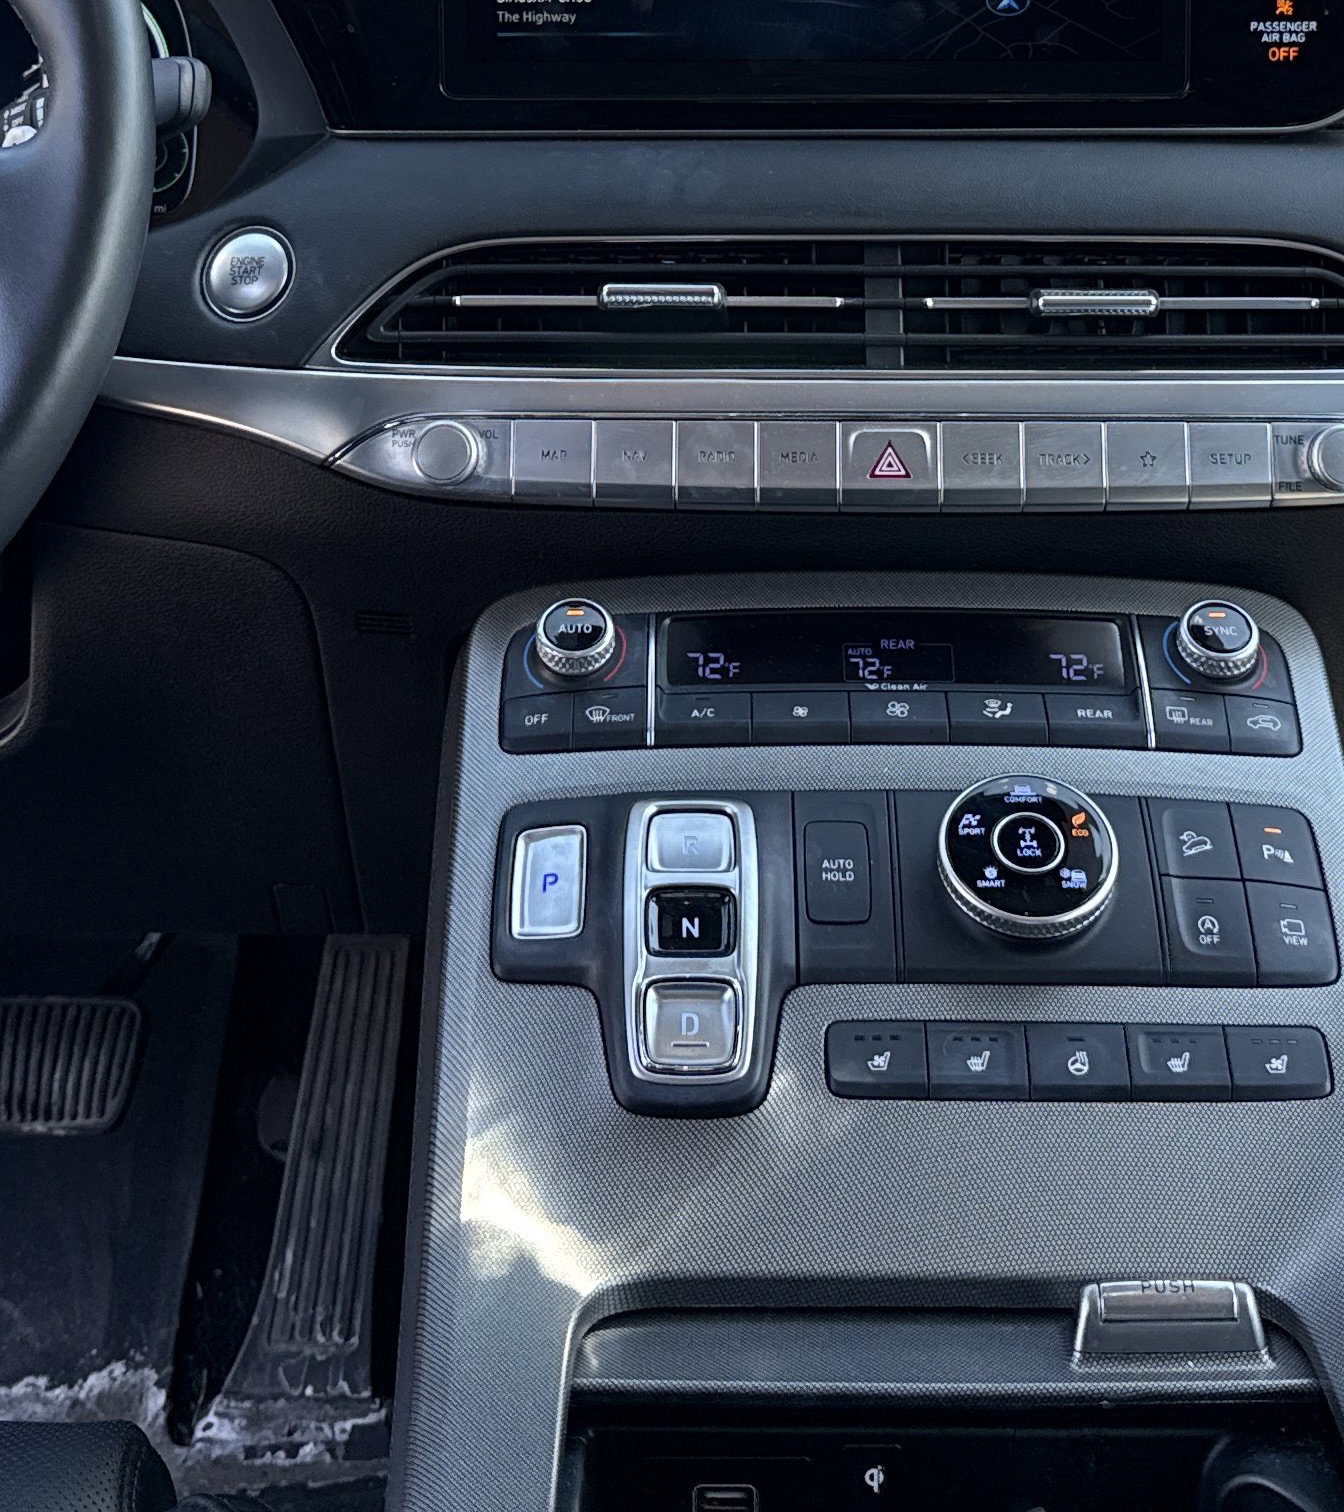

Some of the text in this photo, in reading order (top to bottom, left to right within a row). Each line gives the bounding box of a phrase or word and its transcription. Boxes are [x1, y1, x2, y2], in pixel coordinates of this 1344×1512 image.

[496, 10, 577, 25] The Highway
[1249, 20, 1318, 32] PASSENGER
[1261, 32, 1306, 43] AIR BAG
[1268, 46, 1299, 62] OFF
[230, 255, 266, 267] ENGINE
[229, 265, 264, 277] START
[230, 274, 259, 286] STOP
[392, 428, 416, 439] PWR
[478, 428, 499, 439] VOL
[1274, 433, 1304, 445] TUNE
[541, 448, 567, 461] MAP
[621, 448, 647, 462] NAV
[780, 451, 818, 464] MEDIA
[1209, 452, 1252, 466] SETUP
[1278, 481, 1303, 492] FILE
[558, 623, 594, 635] AUTO
[1203, 625, 1237, 636] SYNC
[880, 638, 915, 649] REAR
[847, 648, 873, 656] AUTO
[880, 683, 929, 691] Clean Air
[606, 713, 635, 722] FRONT
[690, 707, 716, 719] A/C
[1076, 708, 1113, 719] REAR
[524, 713, 550, 727] OFF
[1189, 717, 1214, 727] REAR
[1003, 795, 1044, 805] COMFORT
[957, 826, 986, 837] SPORT
[1071, 828, 1090, 837] ECO
[682, 834, 701, 856] R
[1016, 848, 1043, 858] LOCK
[821, 858, 853, 870] AUTO
[821, 870, 855, 882] HOLD
[542, 872, 559, 893] P
[976, 879, 1006, 889] SMART
[681, 916, 700, 939] N
[1199, 934, 1220, 946] OFF
[1282, 935, 1308, 946] VIEW
[680, 1012, 700, 1037] D
[1140, 1279, 1195, 1294] PUSH
